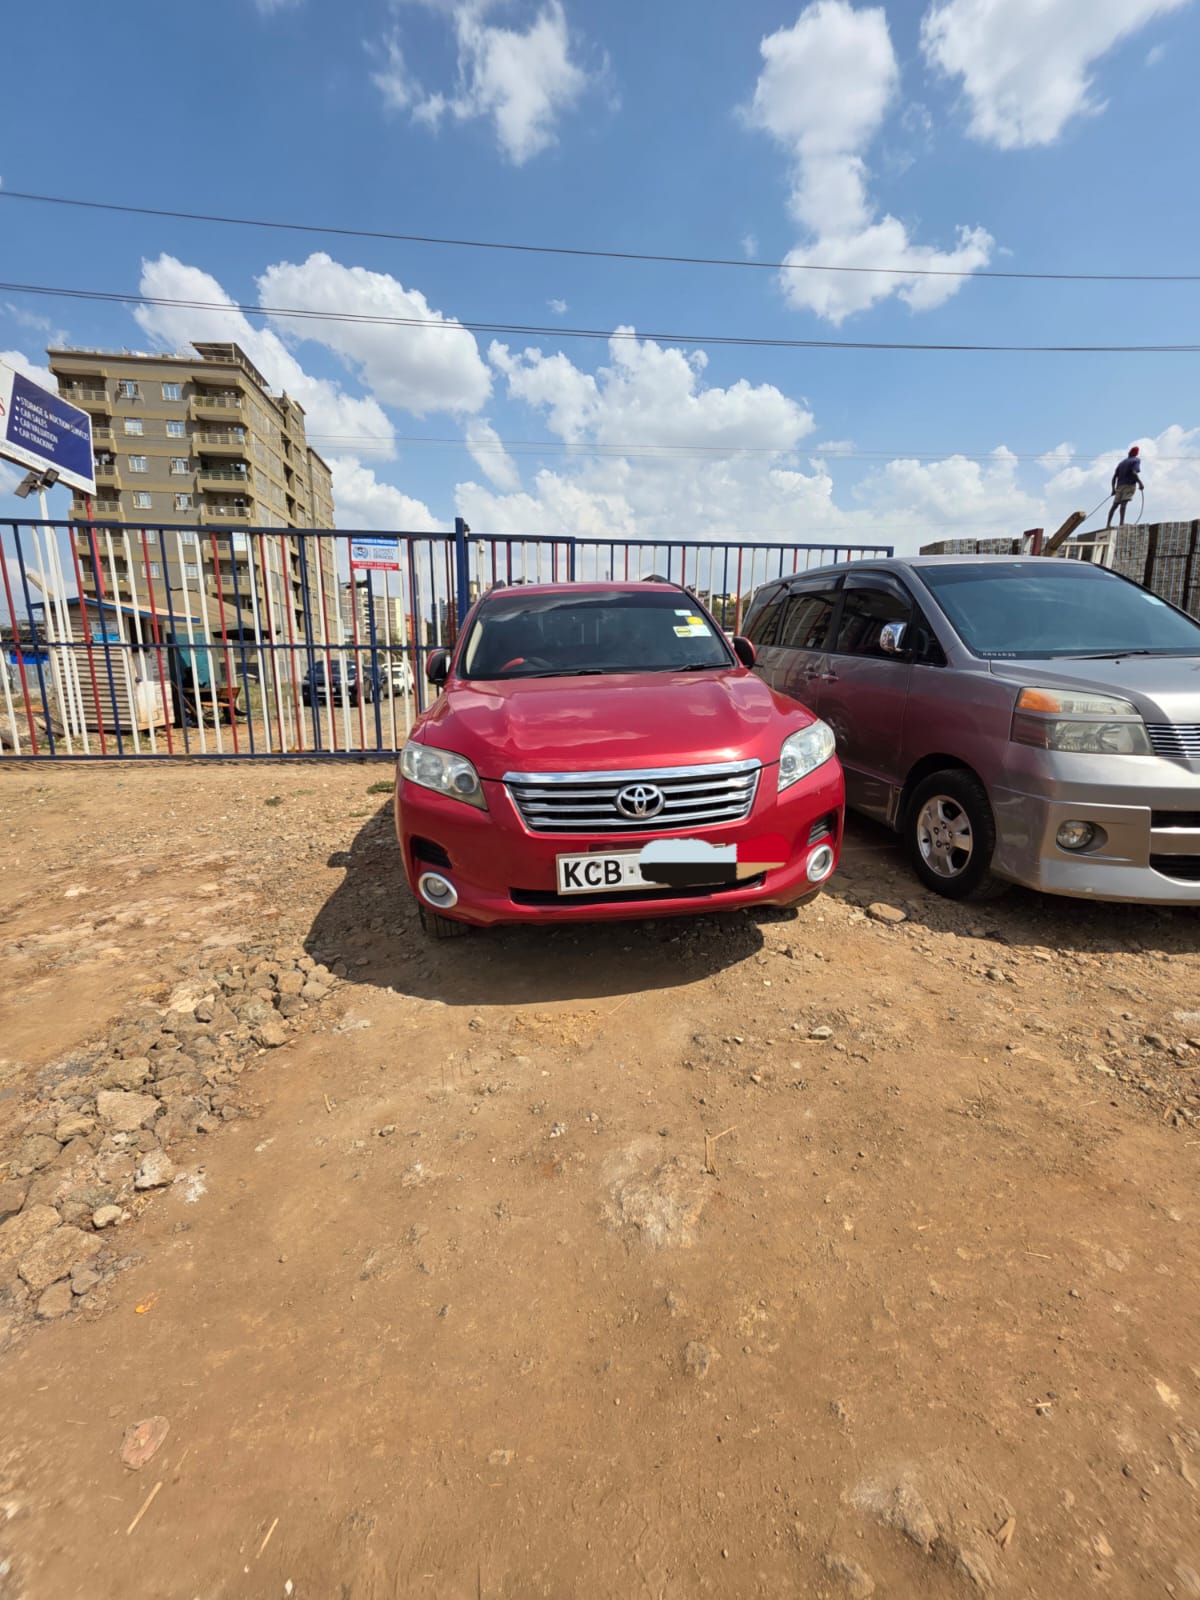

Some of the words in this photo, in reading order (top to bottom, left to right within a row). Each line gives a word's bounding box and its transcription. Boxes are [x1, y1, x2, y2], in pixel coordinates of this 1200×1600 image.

[20, 396, 43, 416] STORAGE
[44, 410, 49, 419] &
[20, 407, 33, 420] CAR
[31, 413, 48, 429] SALES
[18, 427, 31, 440] CAR
[30, 432, 55, 452] TRACKING
[20, 417, 31, 430] CAR
[30, 423, 59, 444] VALUATION
[563, 859, 622, 888] KCB
